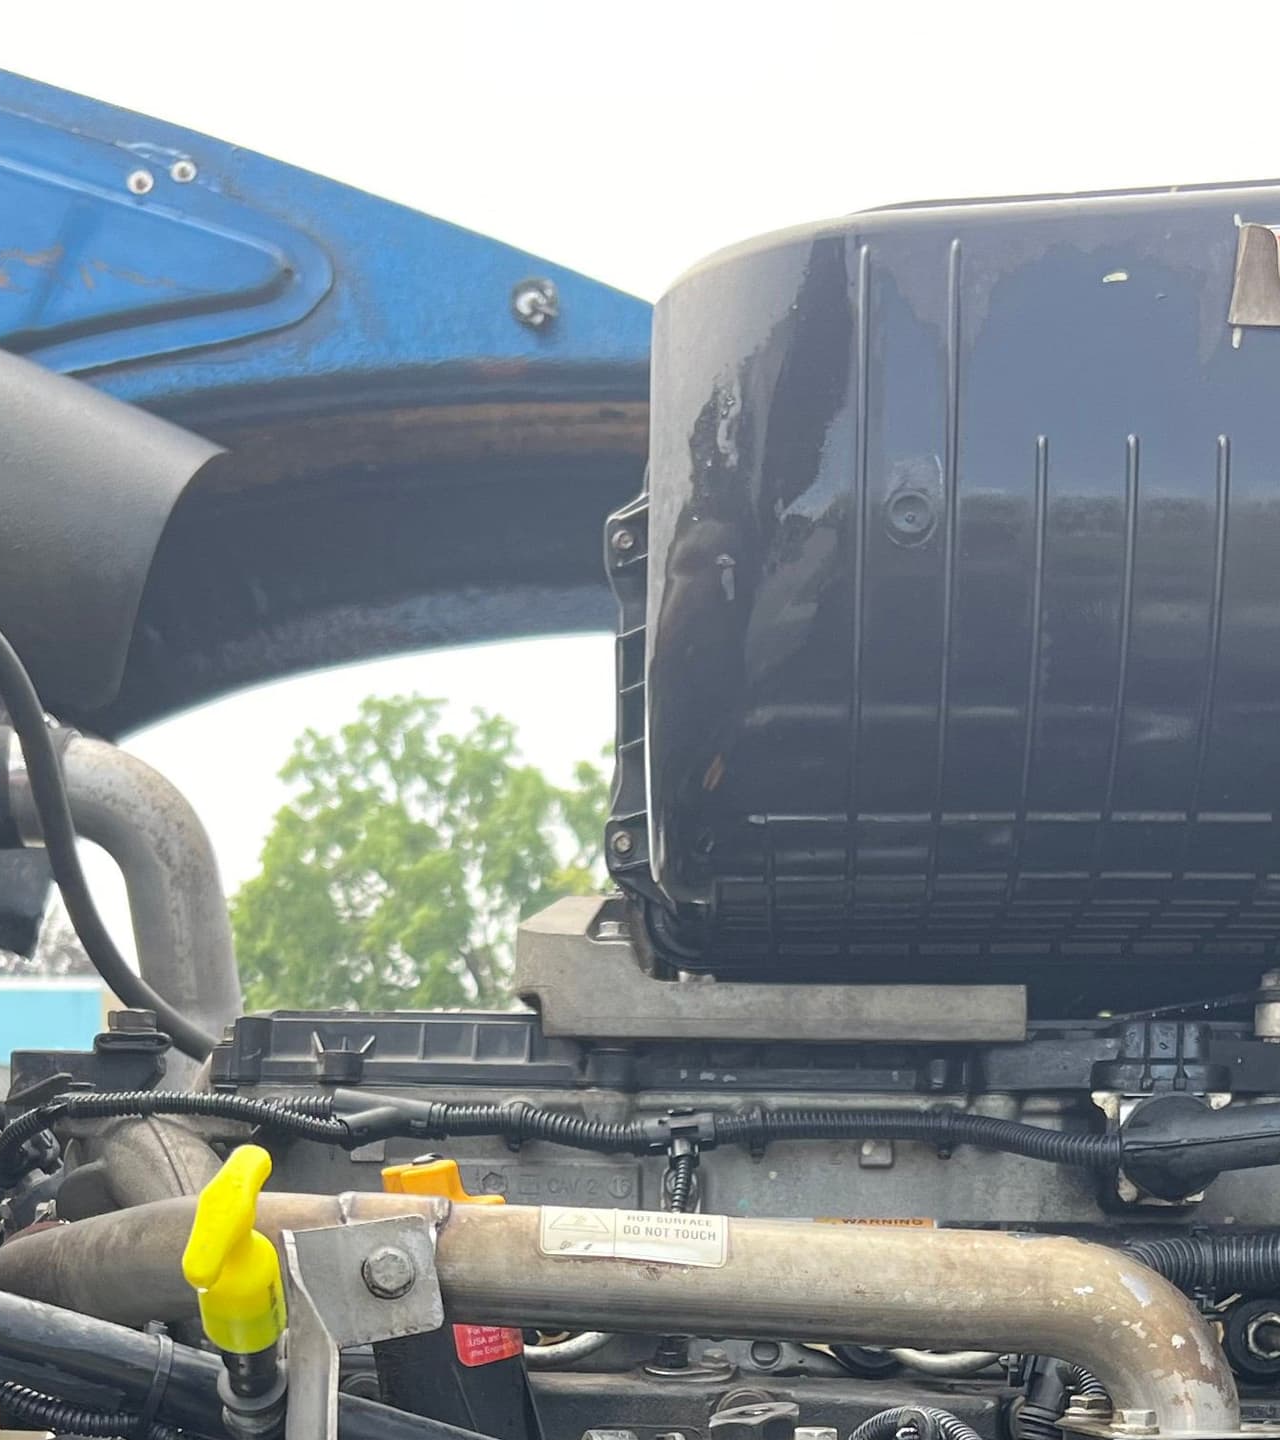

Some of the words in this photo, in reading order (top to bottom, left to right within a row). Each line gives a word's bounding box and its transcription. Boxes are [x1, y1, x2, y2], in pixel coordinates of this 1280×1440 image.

[623, 1225, 640, 1236] DO
[644, 1226, 669, 1239] NOT
[674, 1229, 716, 1241] TOUCH
